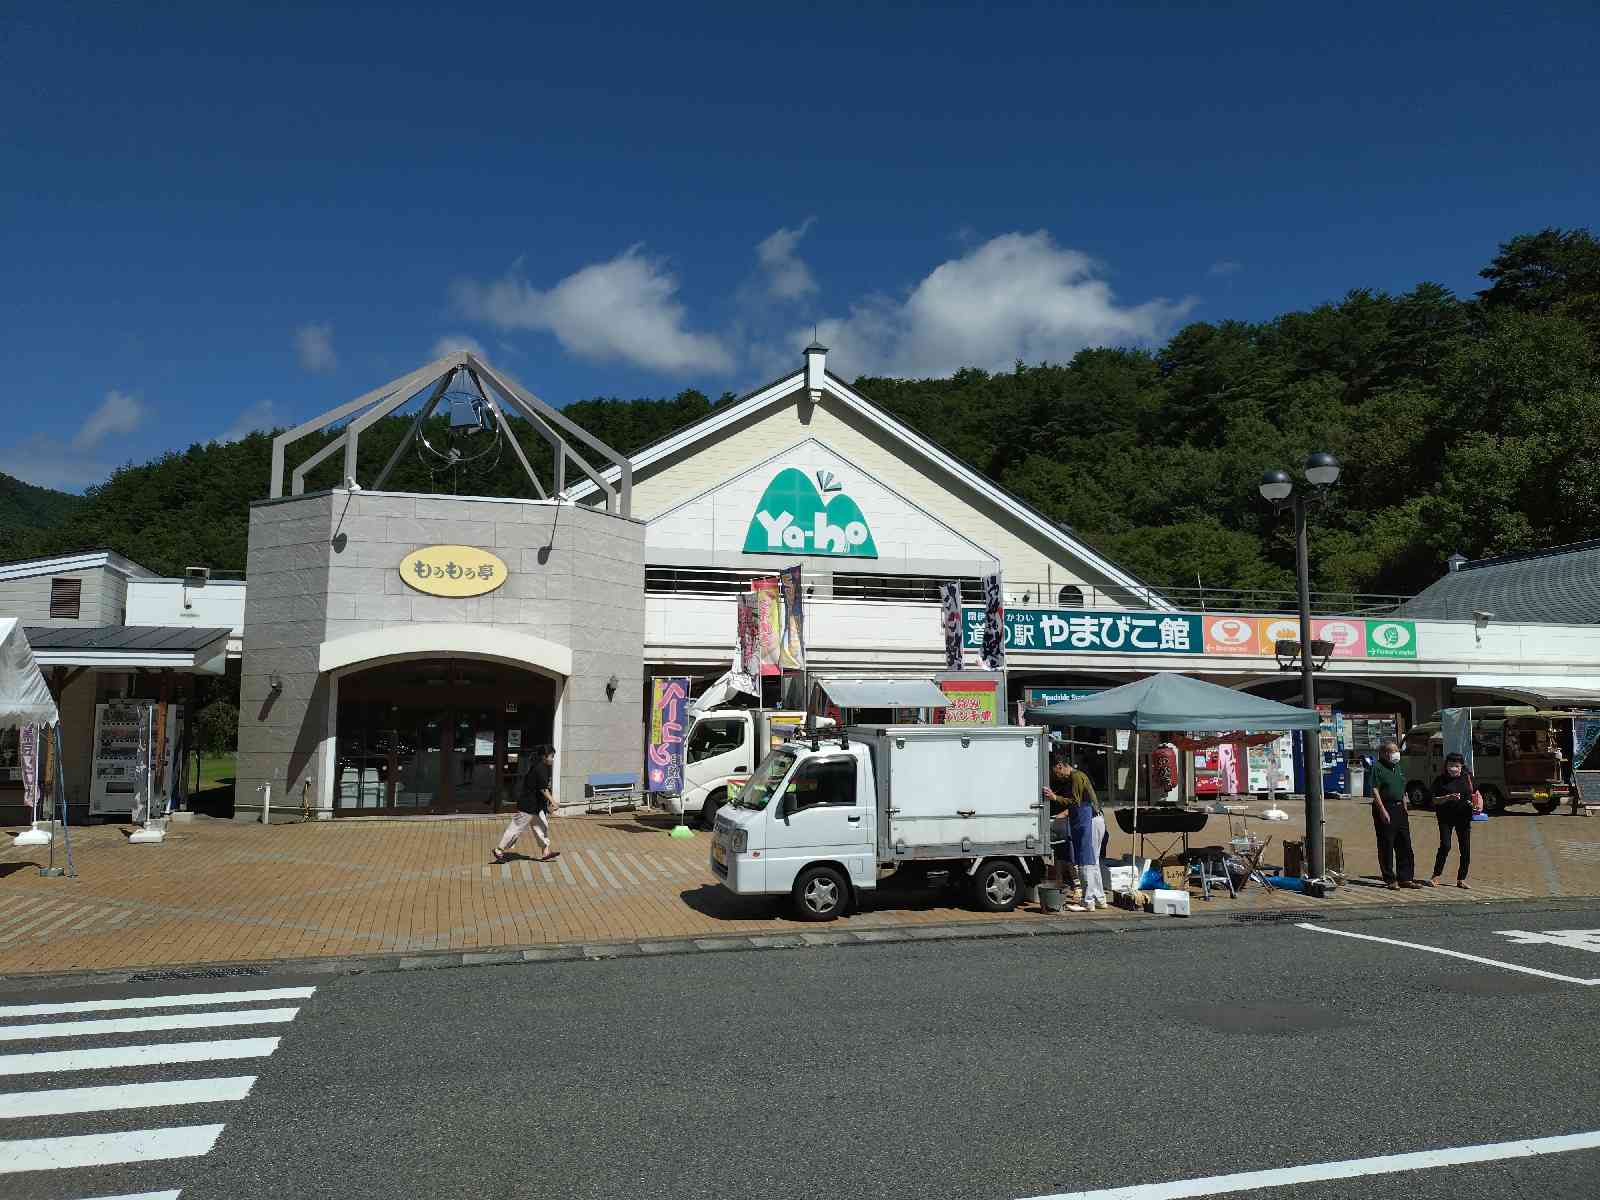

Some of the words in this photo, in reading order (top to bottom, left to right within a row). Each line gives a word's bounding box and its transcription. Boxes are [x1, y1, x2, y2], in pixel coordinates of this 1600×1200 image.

[756, 509, 868, 553] Ya-ho
[1006, 612, 1034, 622] かわい
[1040, 614, 1190, 650] やまびこ館
